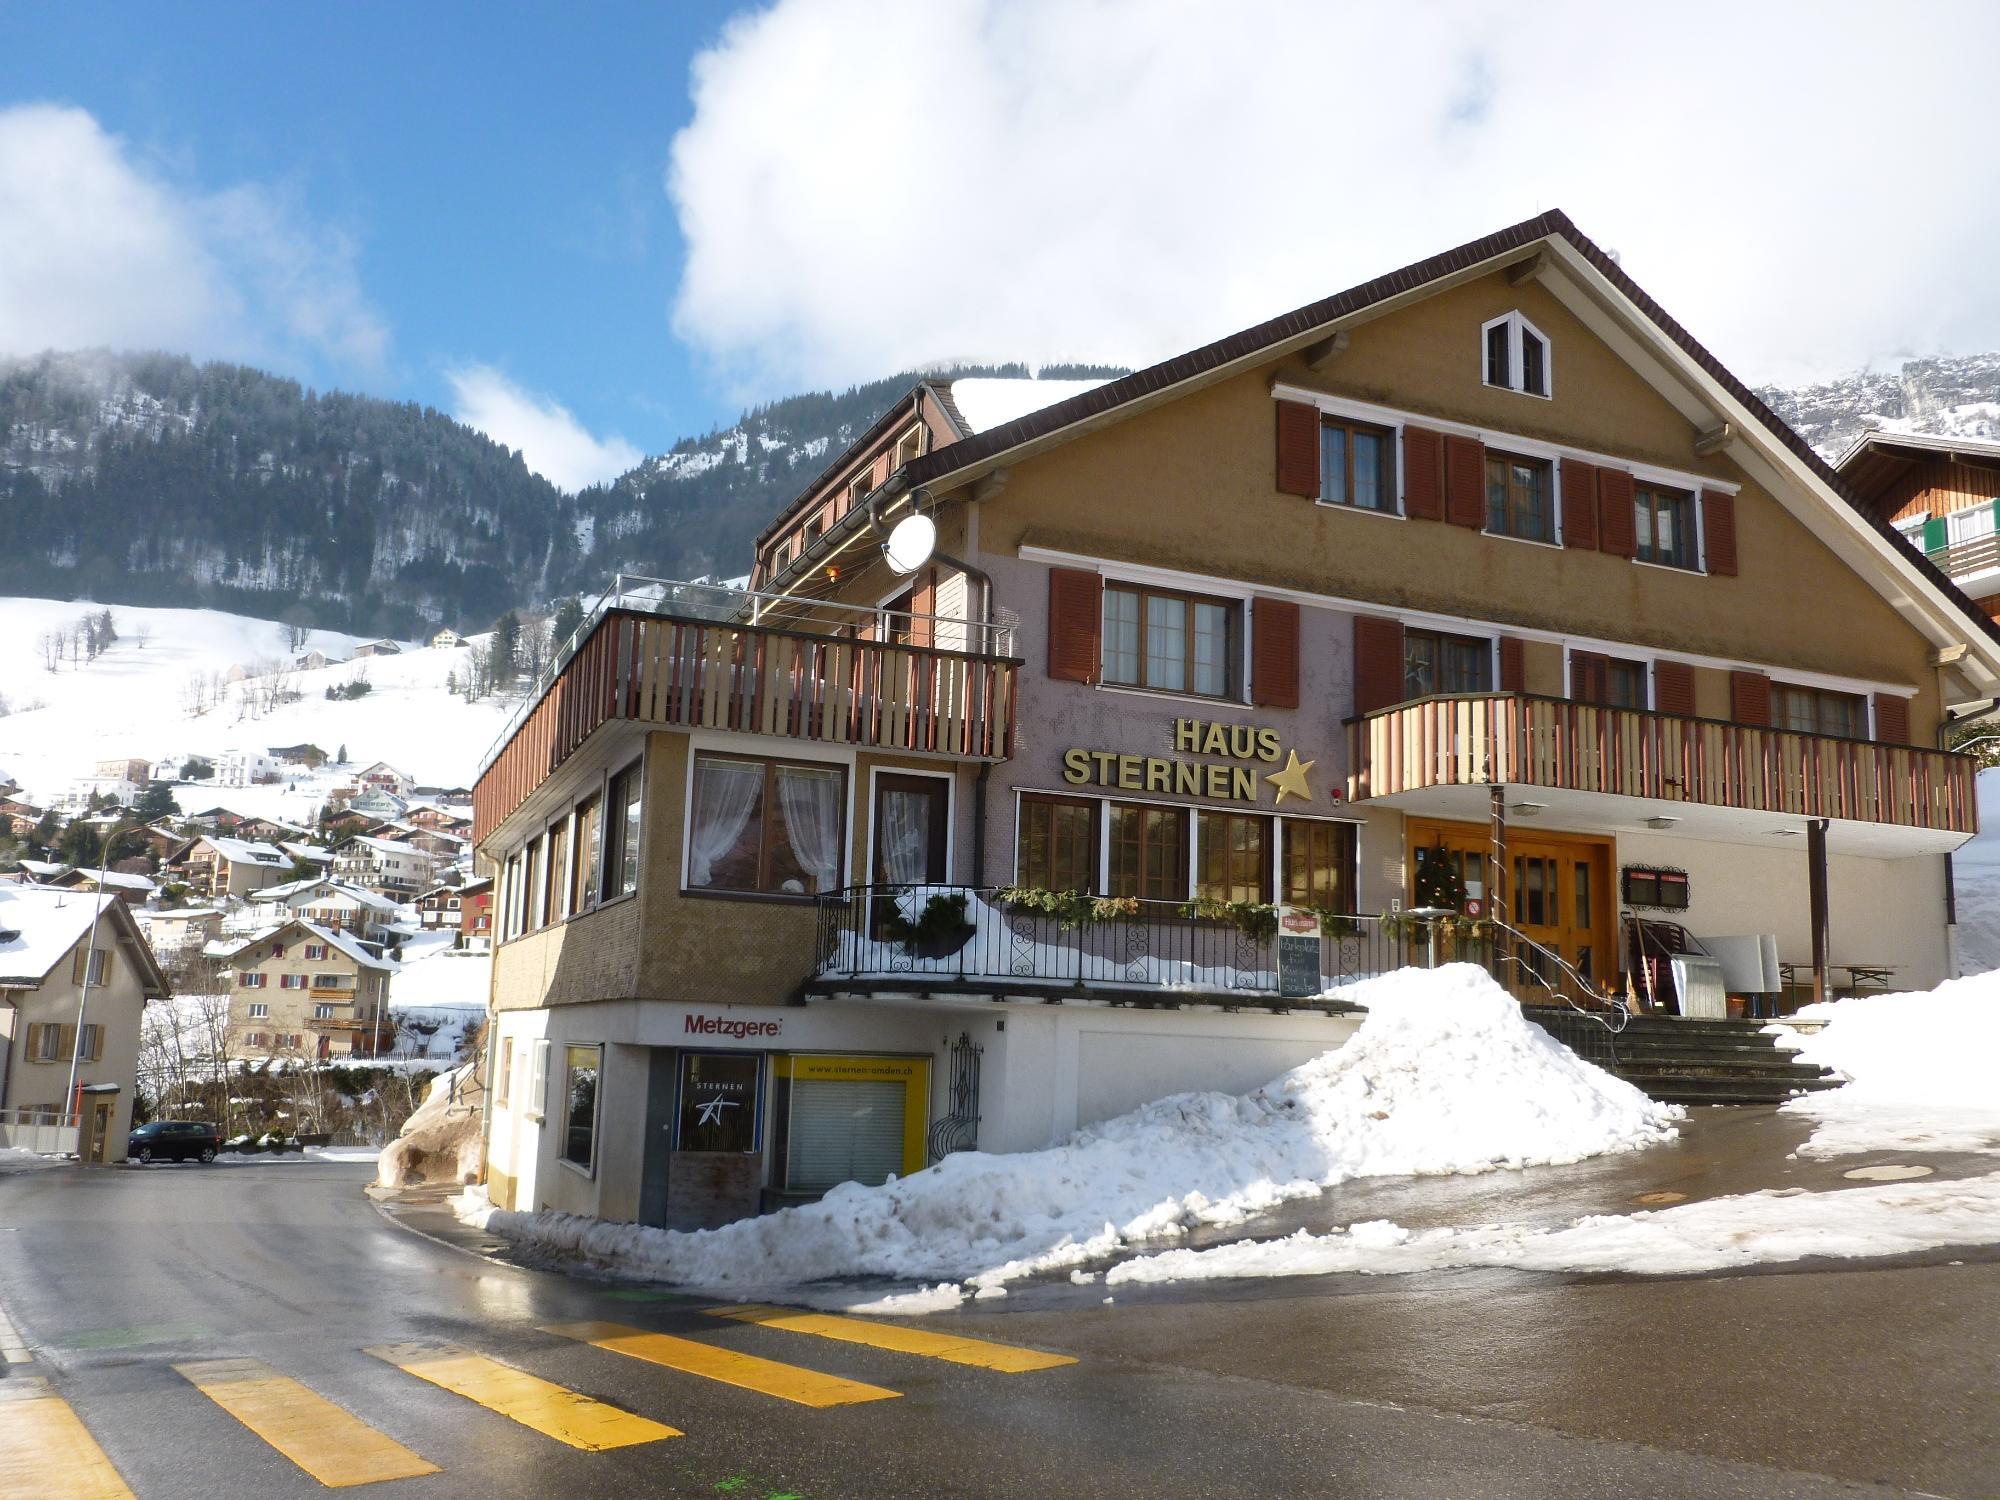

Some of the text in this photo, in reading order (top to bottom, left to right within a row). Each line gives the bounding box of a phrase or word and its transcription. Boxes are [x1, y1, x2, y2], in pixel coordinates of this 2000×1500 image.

[1176, 718, 1282, 762] HAUS
[1063, 748, 1257, 801] STERNEN
[808, 1066, 913, 1075] www.sternen-amden.ch
[696, 1082, 743, 1091] STERNEN
